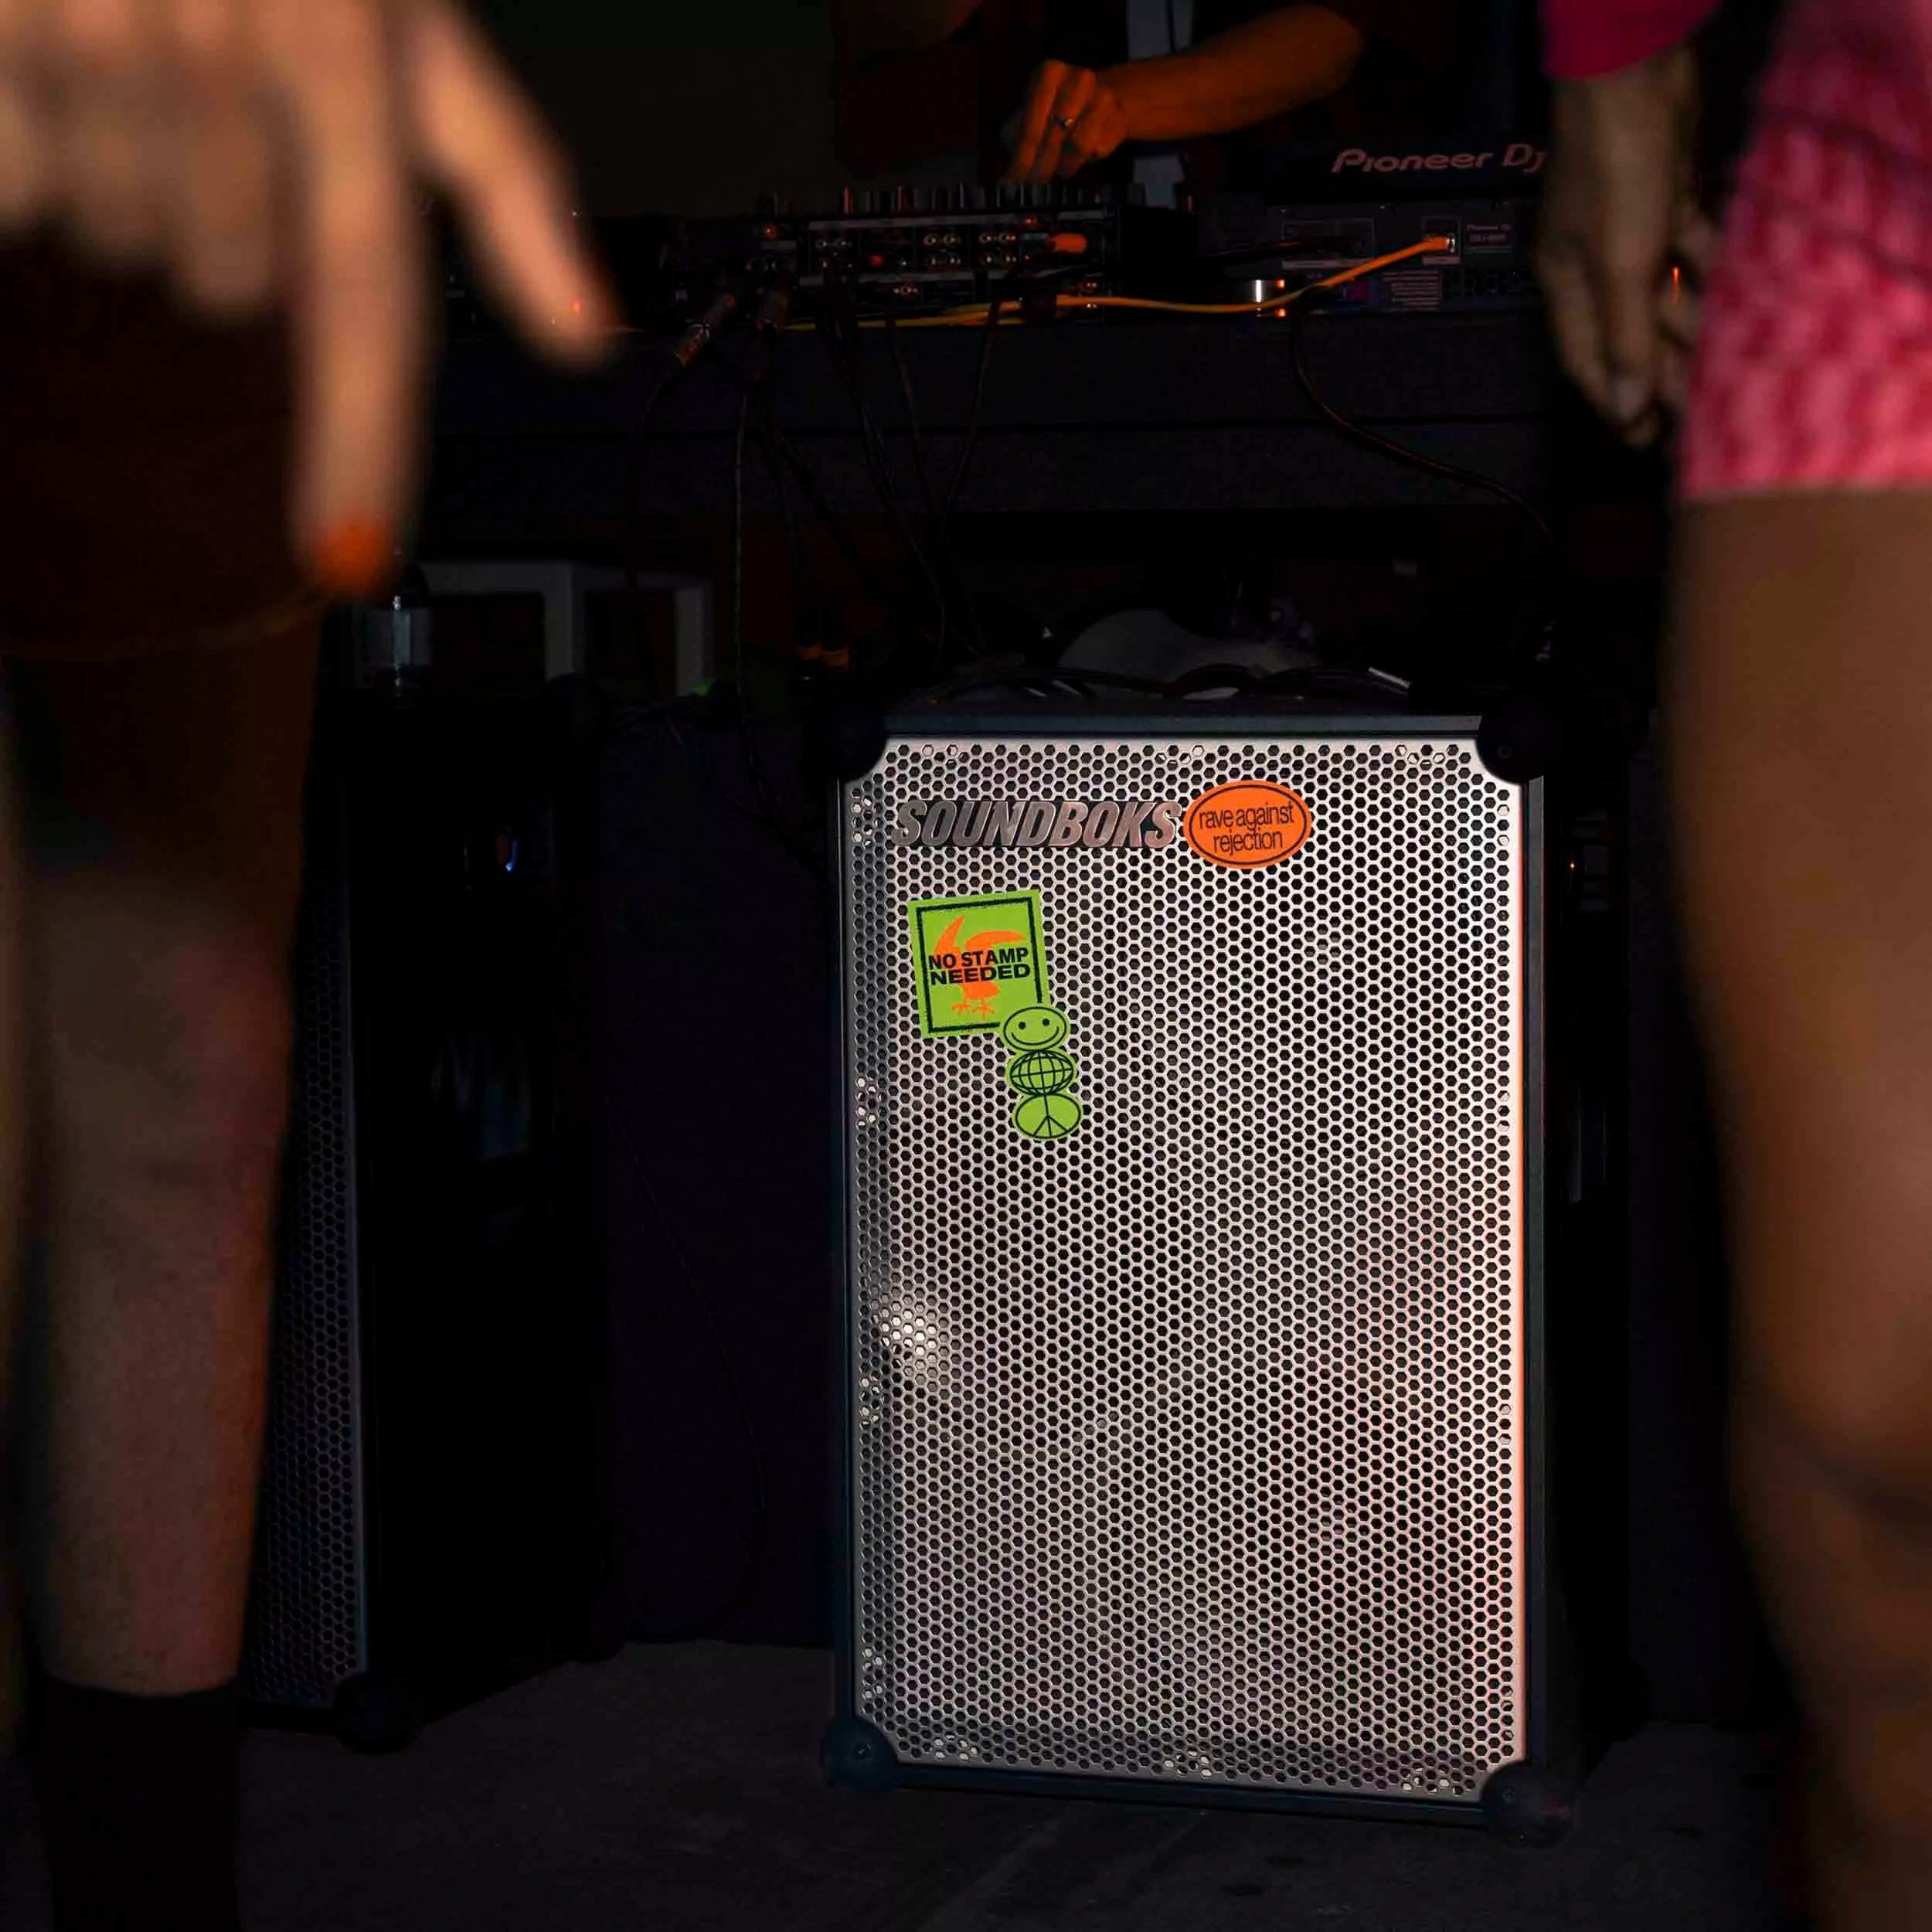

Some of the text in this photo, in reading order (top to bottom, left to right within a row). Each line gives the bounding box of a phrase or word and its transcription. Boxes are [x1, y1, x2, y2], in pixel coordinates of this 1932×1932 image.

[1331, 147, 1495, 174] Pioneer
[890, 800, 1183, 849] SOUNDBOKS
[1199, 801, 1295, 834] rave against
[1213, 828, 1284, 855] rejection
[928, 947, 1029, 970] NO STAMP
[930, 963, 1031, 985] NEEDED
